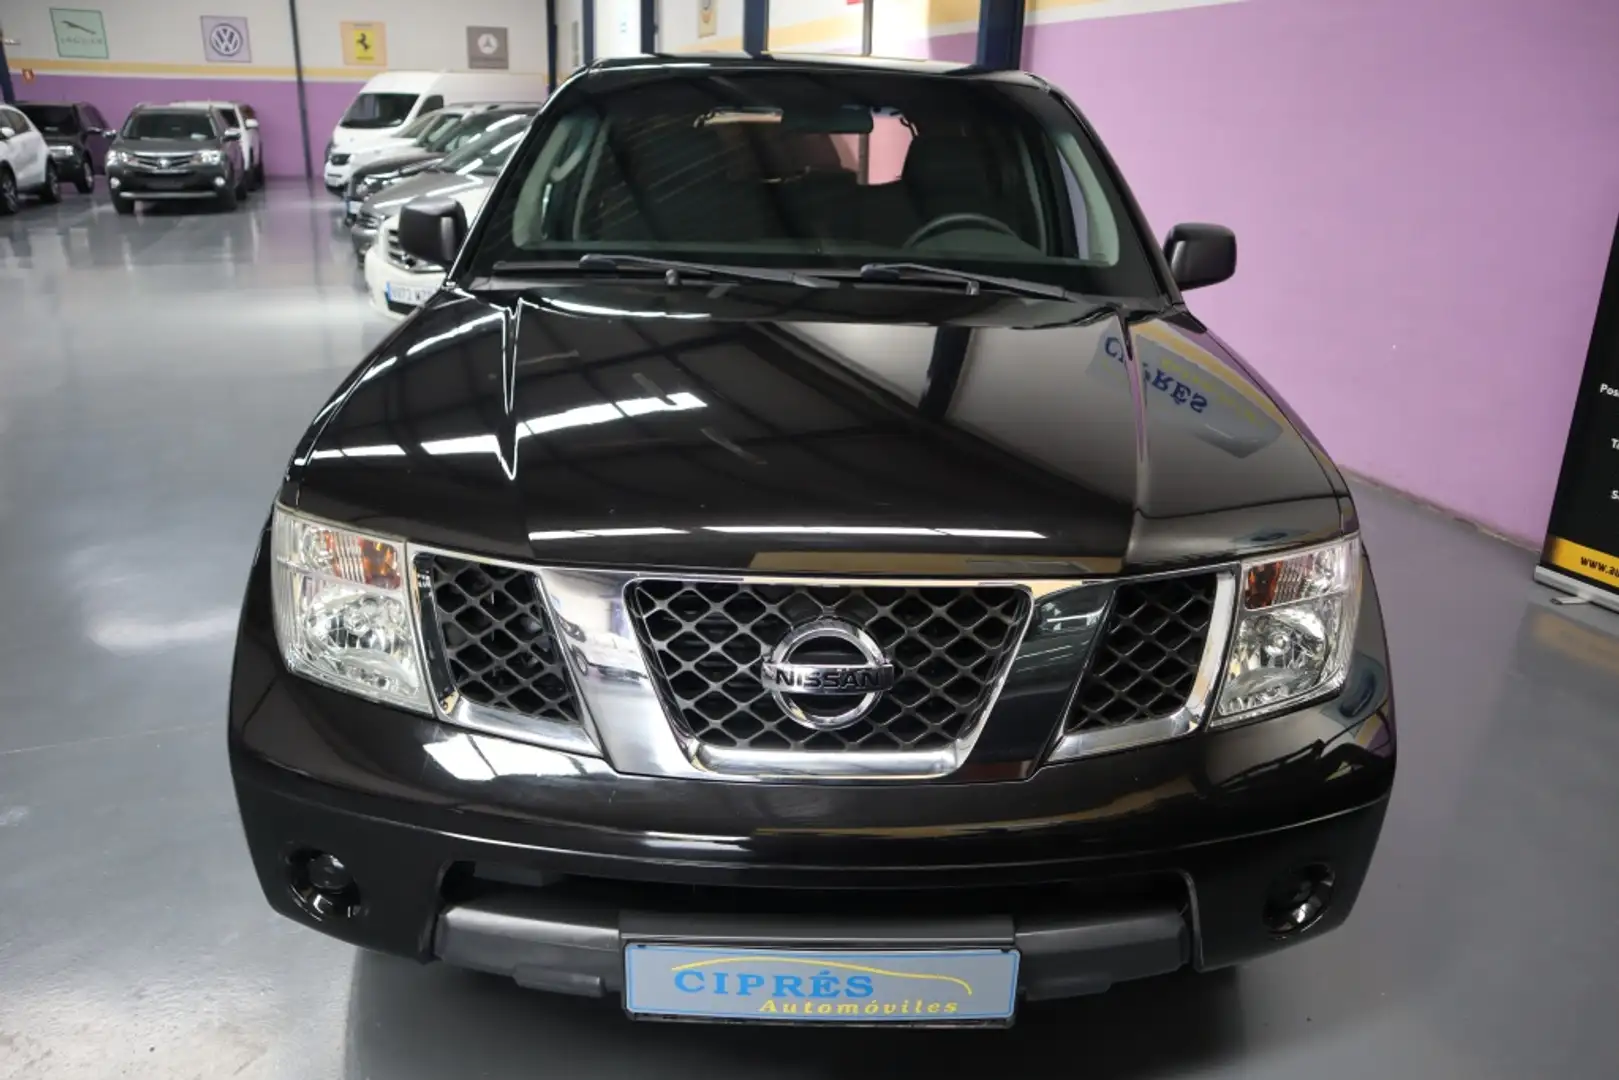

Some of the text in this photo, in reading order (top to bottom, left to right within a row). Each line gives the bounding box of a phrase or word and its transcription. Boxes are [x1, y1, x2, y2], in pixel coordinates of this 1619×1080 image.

[775, 669, 880, 689] NISSAN
[674, 969, 874, 998] CIPRÉS
[759, 999, 958, 1014] Automóviles
